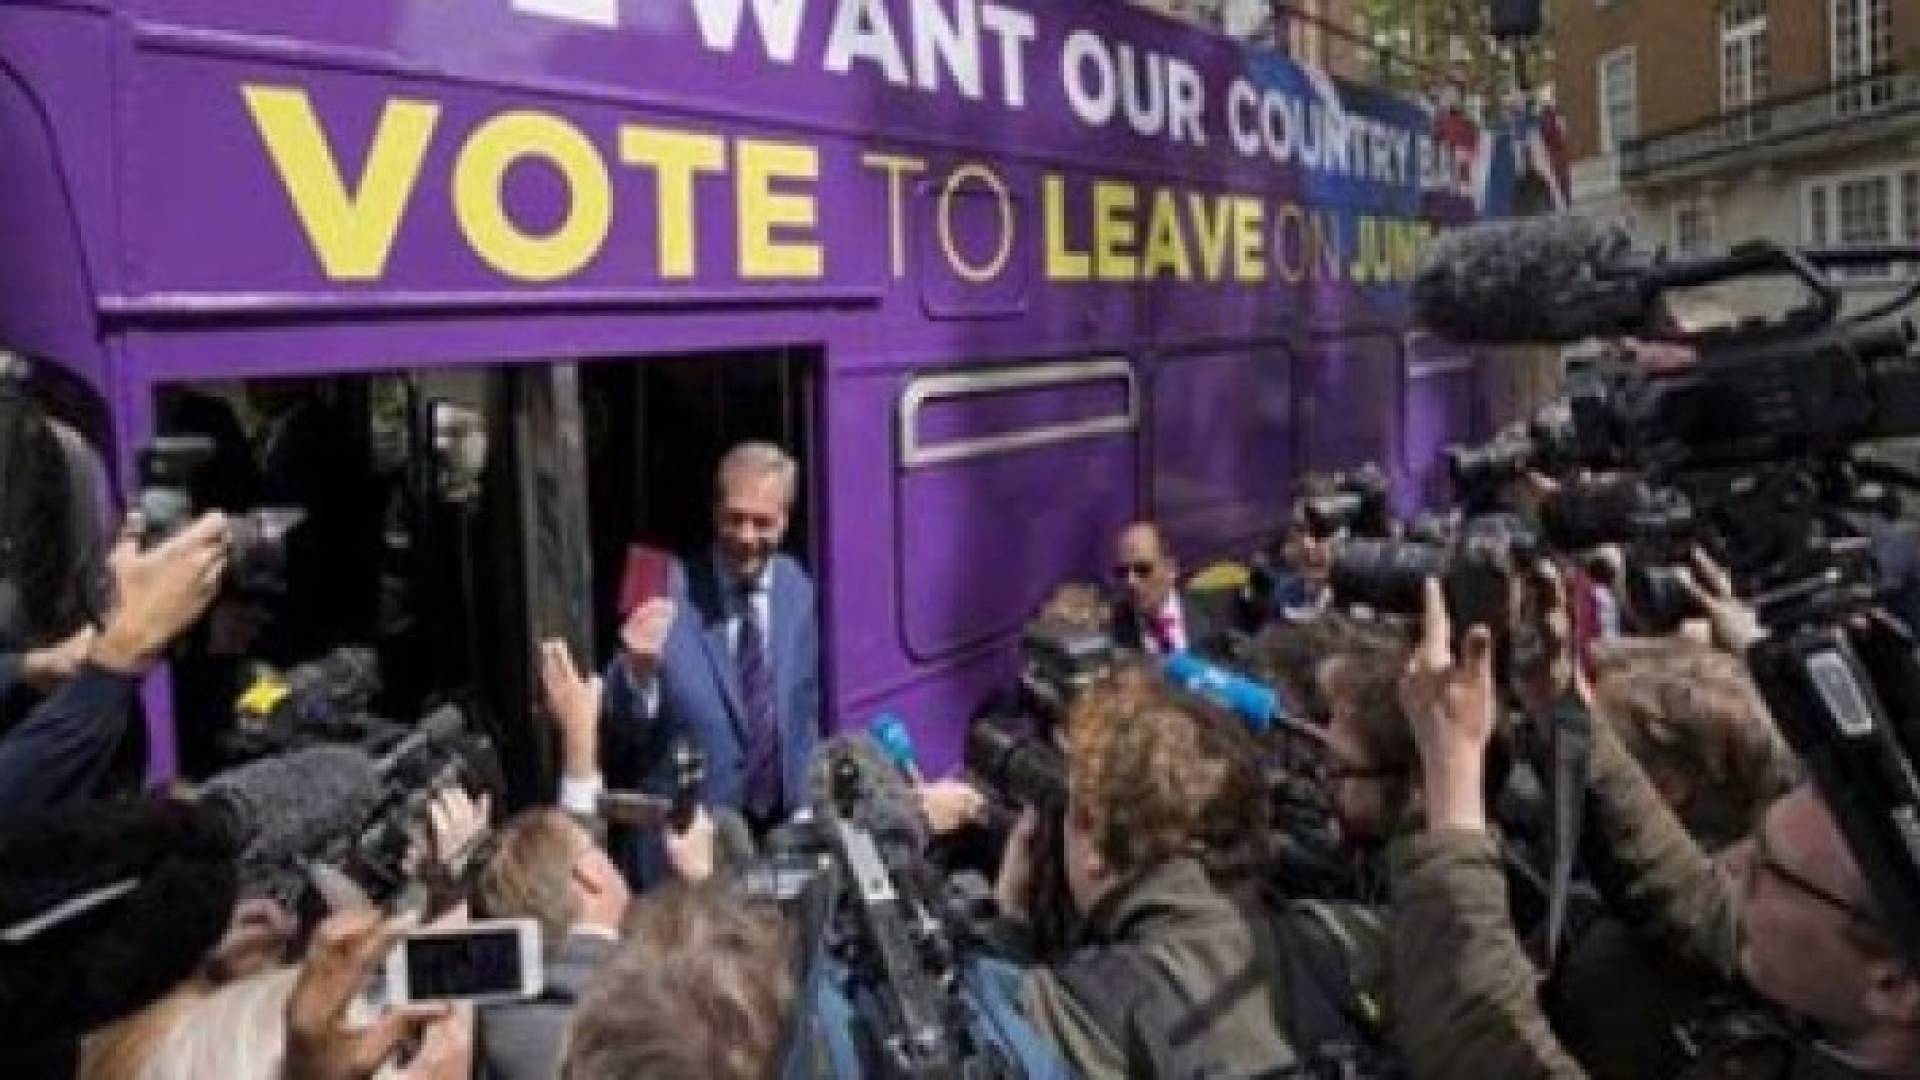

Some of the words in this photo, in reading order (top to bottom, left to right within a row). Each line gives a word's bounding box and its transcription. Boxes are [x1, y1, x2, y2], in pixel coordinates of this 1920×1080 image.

[241, 84, 824, 281] VOTE
[863, 153, 1014, 282] TO
[1043, 174, 1265, 282] LEAVE
[1274, 205, 1340, 281] ON
[1062, 29, 1205, 145] OUR
[1228, 77, 1408, 185] COUNTRY
